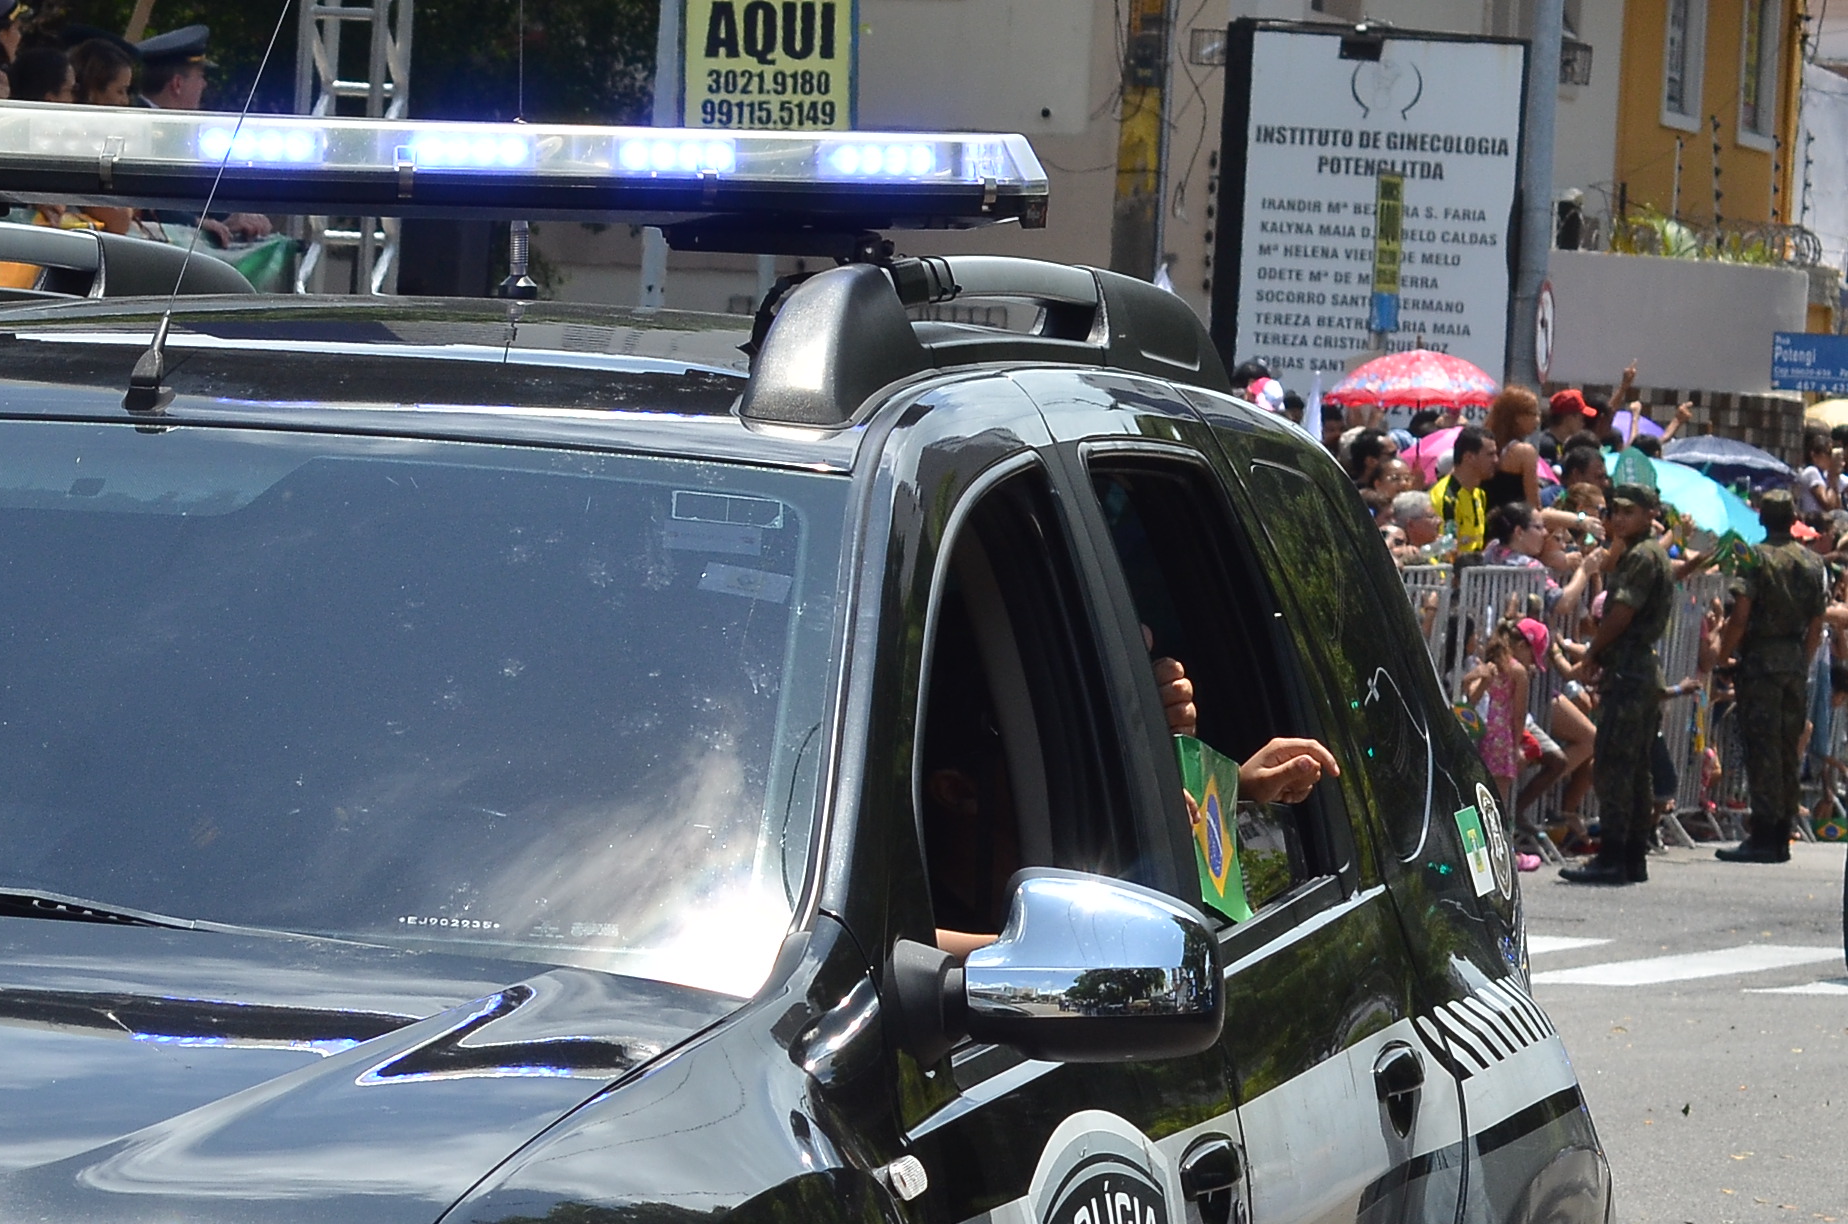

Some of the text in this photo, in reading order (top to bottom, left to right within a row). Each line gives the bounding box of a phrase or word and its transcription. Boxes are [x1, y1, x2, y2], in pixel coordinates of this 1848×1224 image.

[704, 1, 836, 65] AQUI
[707, 69, 831, 95] 3021.9180
[701, 99, 836, 126] 99115.5149
[1255, 125, 1509, 156] INSTITUTO DE GINECOLOGIA
[1261, 197, 1322, 213] IRANDIR
[1443, 208, 1486, 222] FARIA
[1259, 220, 1314, 236] KALYNA
[1318, 224, 1356, 238] MAIA
[1441, 231, 1497, 246] CALDAS
[1283, 245, 1339, 260] HELENA
[1421, 253, 1461, 267] MELO
[1257, 266, 1304, 282] ODETE
[1334, 272, 1352, 285] DE
[1256, 289, 1326, 306] SOCORRO
[1399, 298, 1465, 314] ERMANO
[1255, 312, 1311, 327] TEREZA
[1433, 323, 1471, 337] MAIA
[1253, 331, 1308, 347] TEREZA
